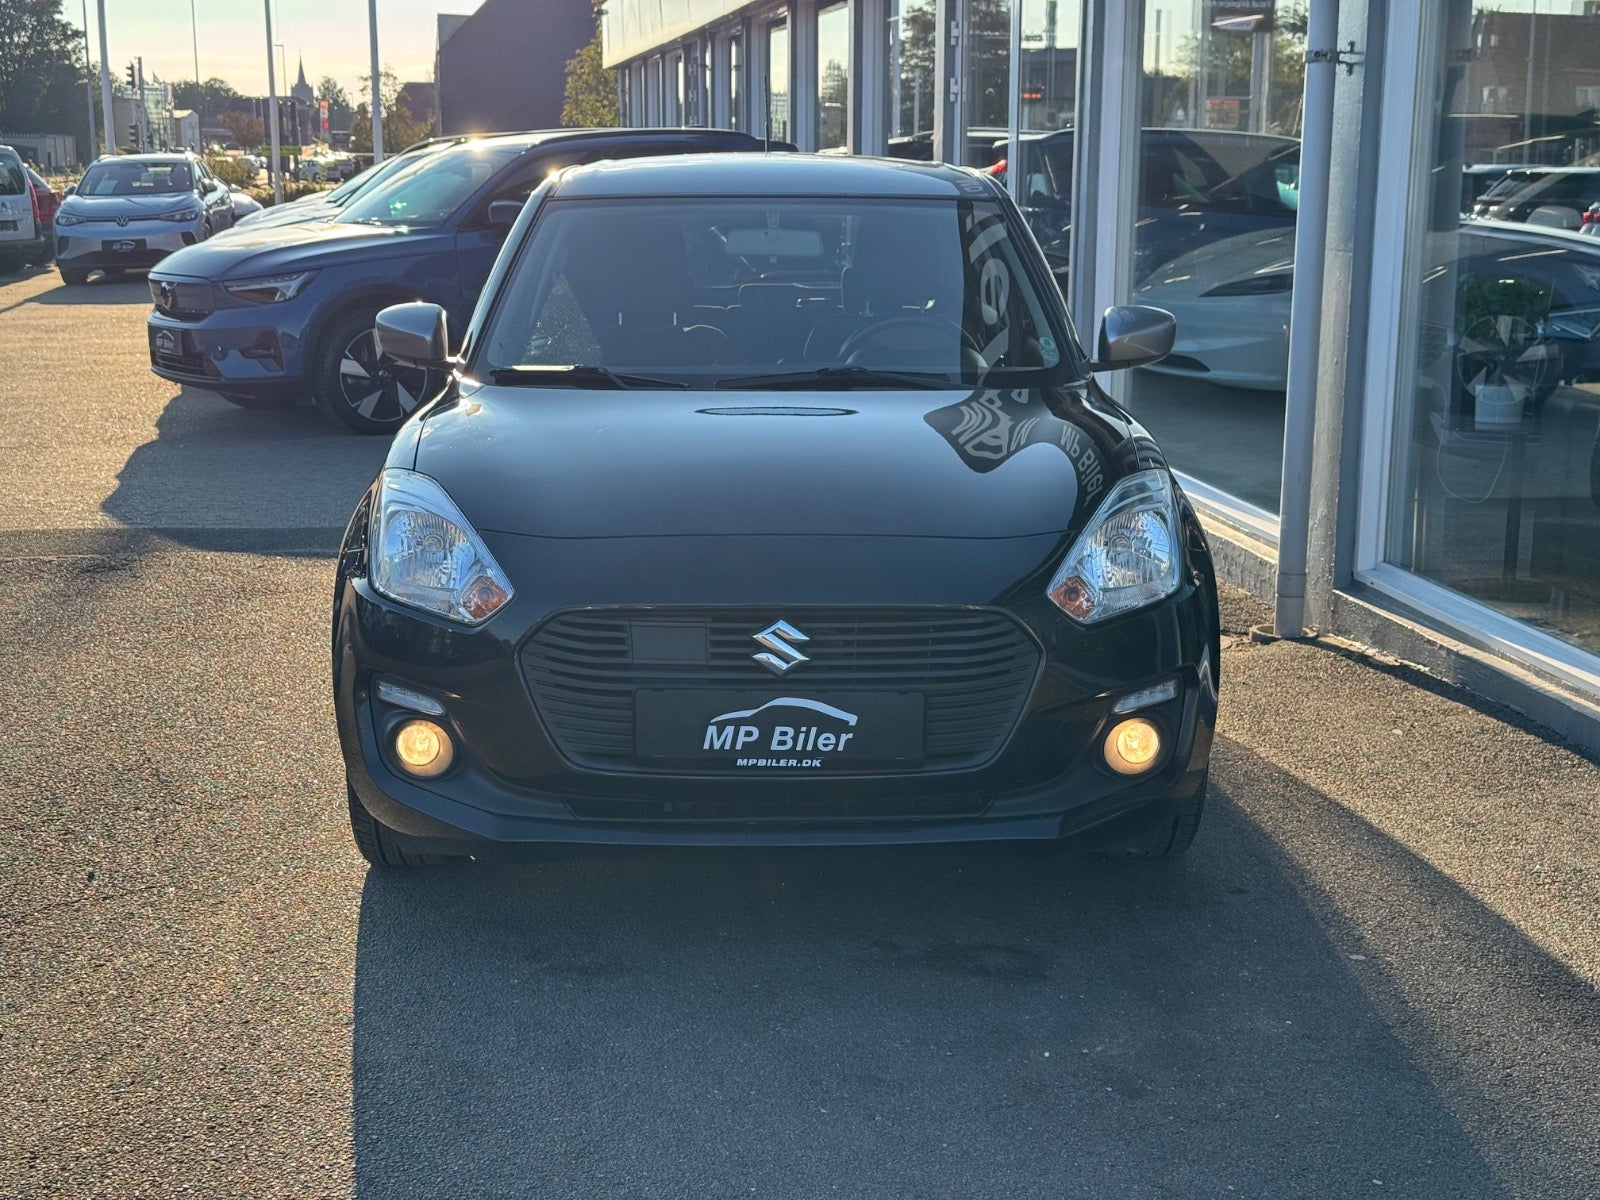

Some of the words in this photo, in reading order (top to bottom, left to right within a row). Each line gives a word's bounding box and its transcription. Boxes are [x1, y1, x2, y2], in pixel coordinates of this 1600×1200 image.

[703, 725, 759, 750] MP
[770, 726, 853, 752] Biler
[736, 758, 822, 768] MPBILER.DK
